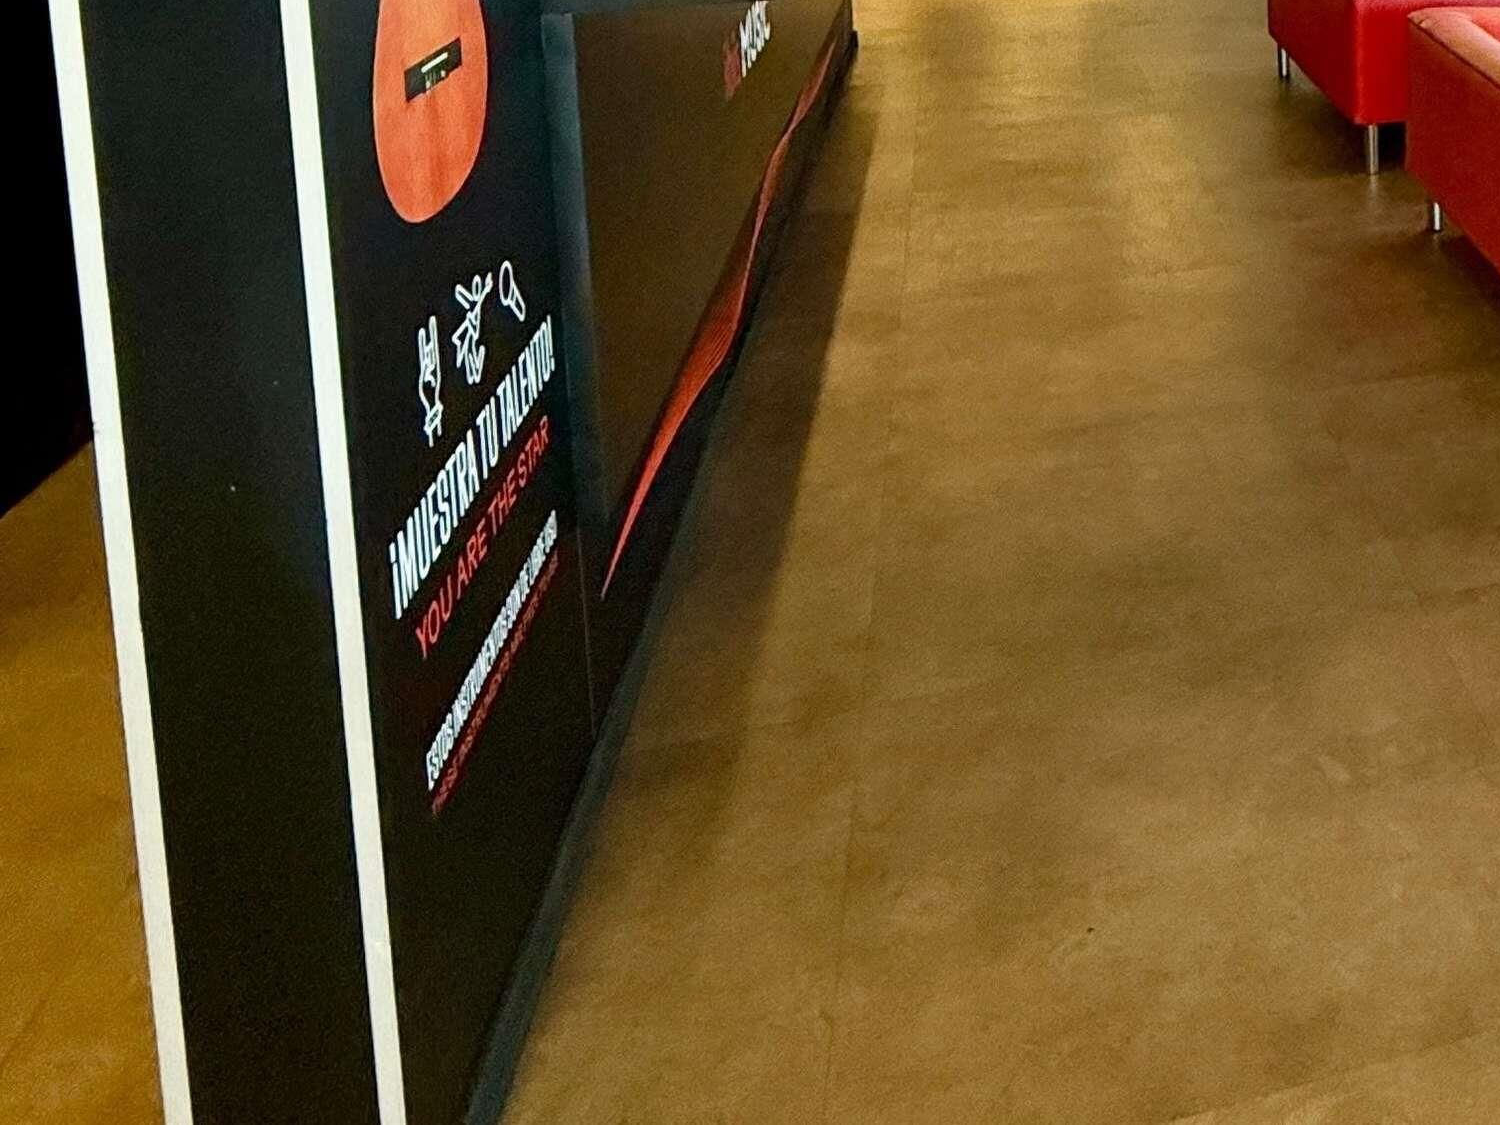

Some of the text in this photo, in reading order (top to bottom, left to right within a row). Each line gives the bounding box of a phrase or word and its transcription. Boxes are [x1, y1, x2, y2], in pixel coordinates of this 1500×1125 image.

[390, 315, 556, 619] ¡MUESTRA TU TALENTO!
[415, 415, 549, 660] YOU ARE THE STAR
